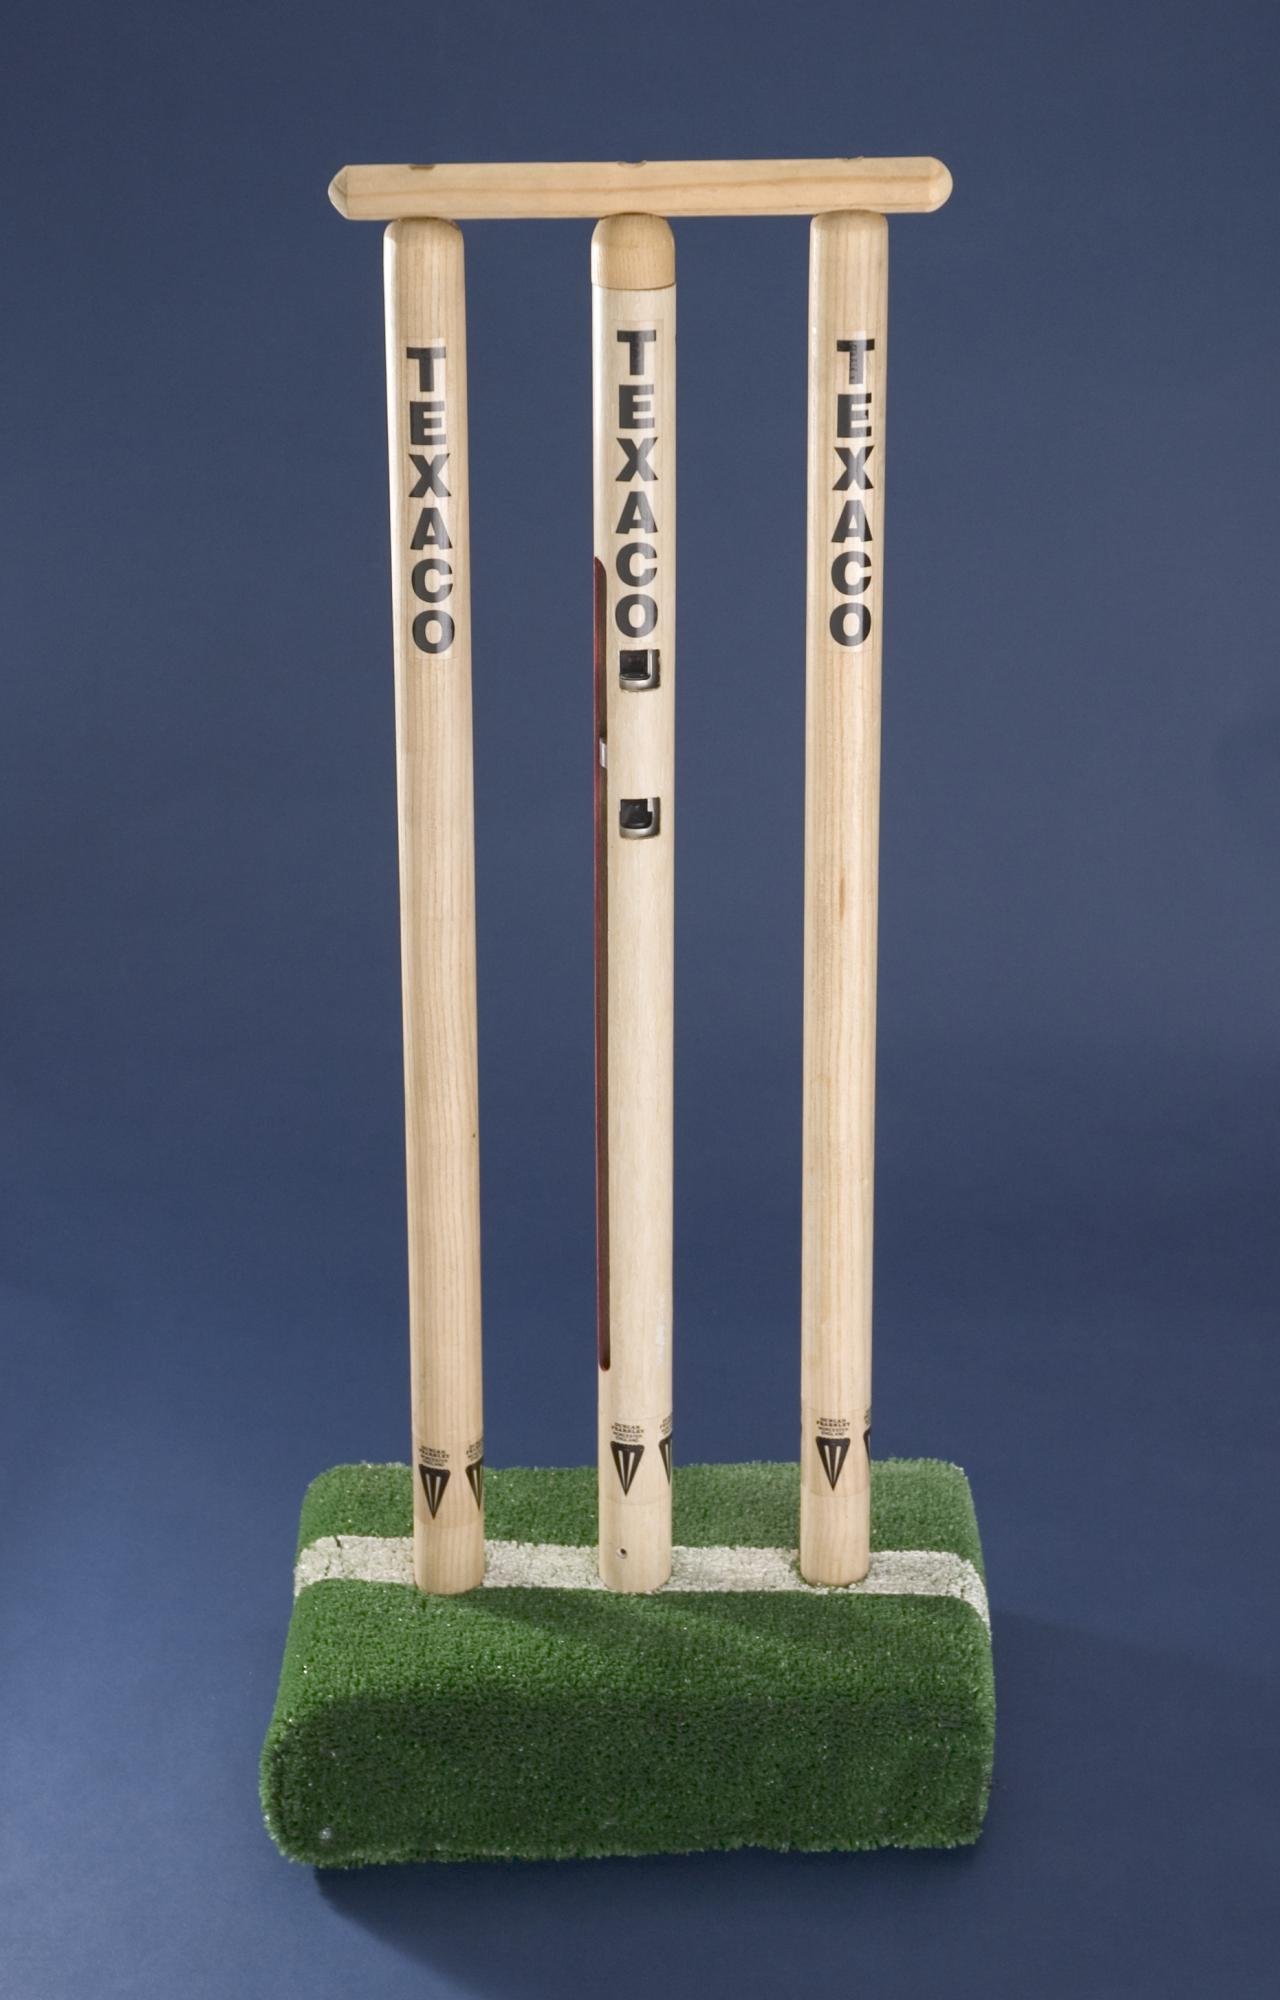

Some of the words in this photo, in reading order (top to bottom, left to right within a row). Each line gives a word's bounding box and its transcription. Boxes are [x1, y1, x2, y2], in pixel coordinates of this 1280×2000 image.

[406, 347, 455, 654] TEXACO
[615, 329, 659, 638] TEXACO
[829, 338, 876, 647] TEXACO
